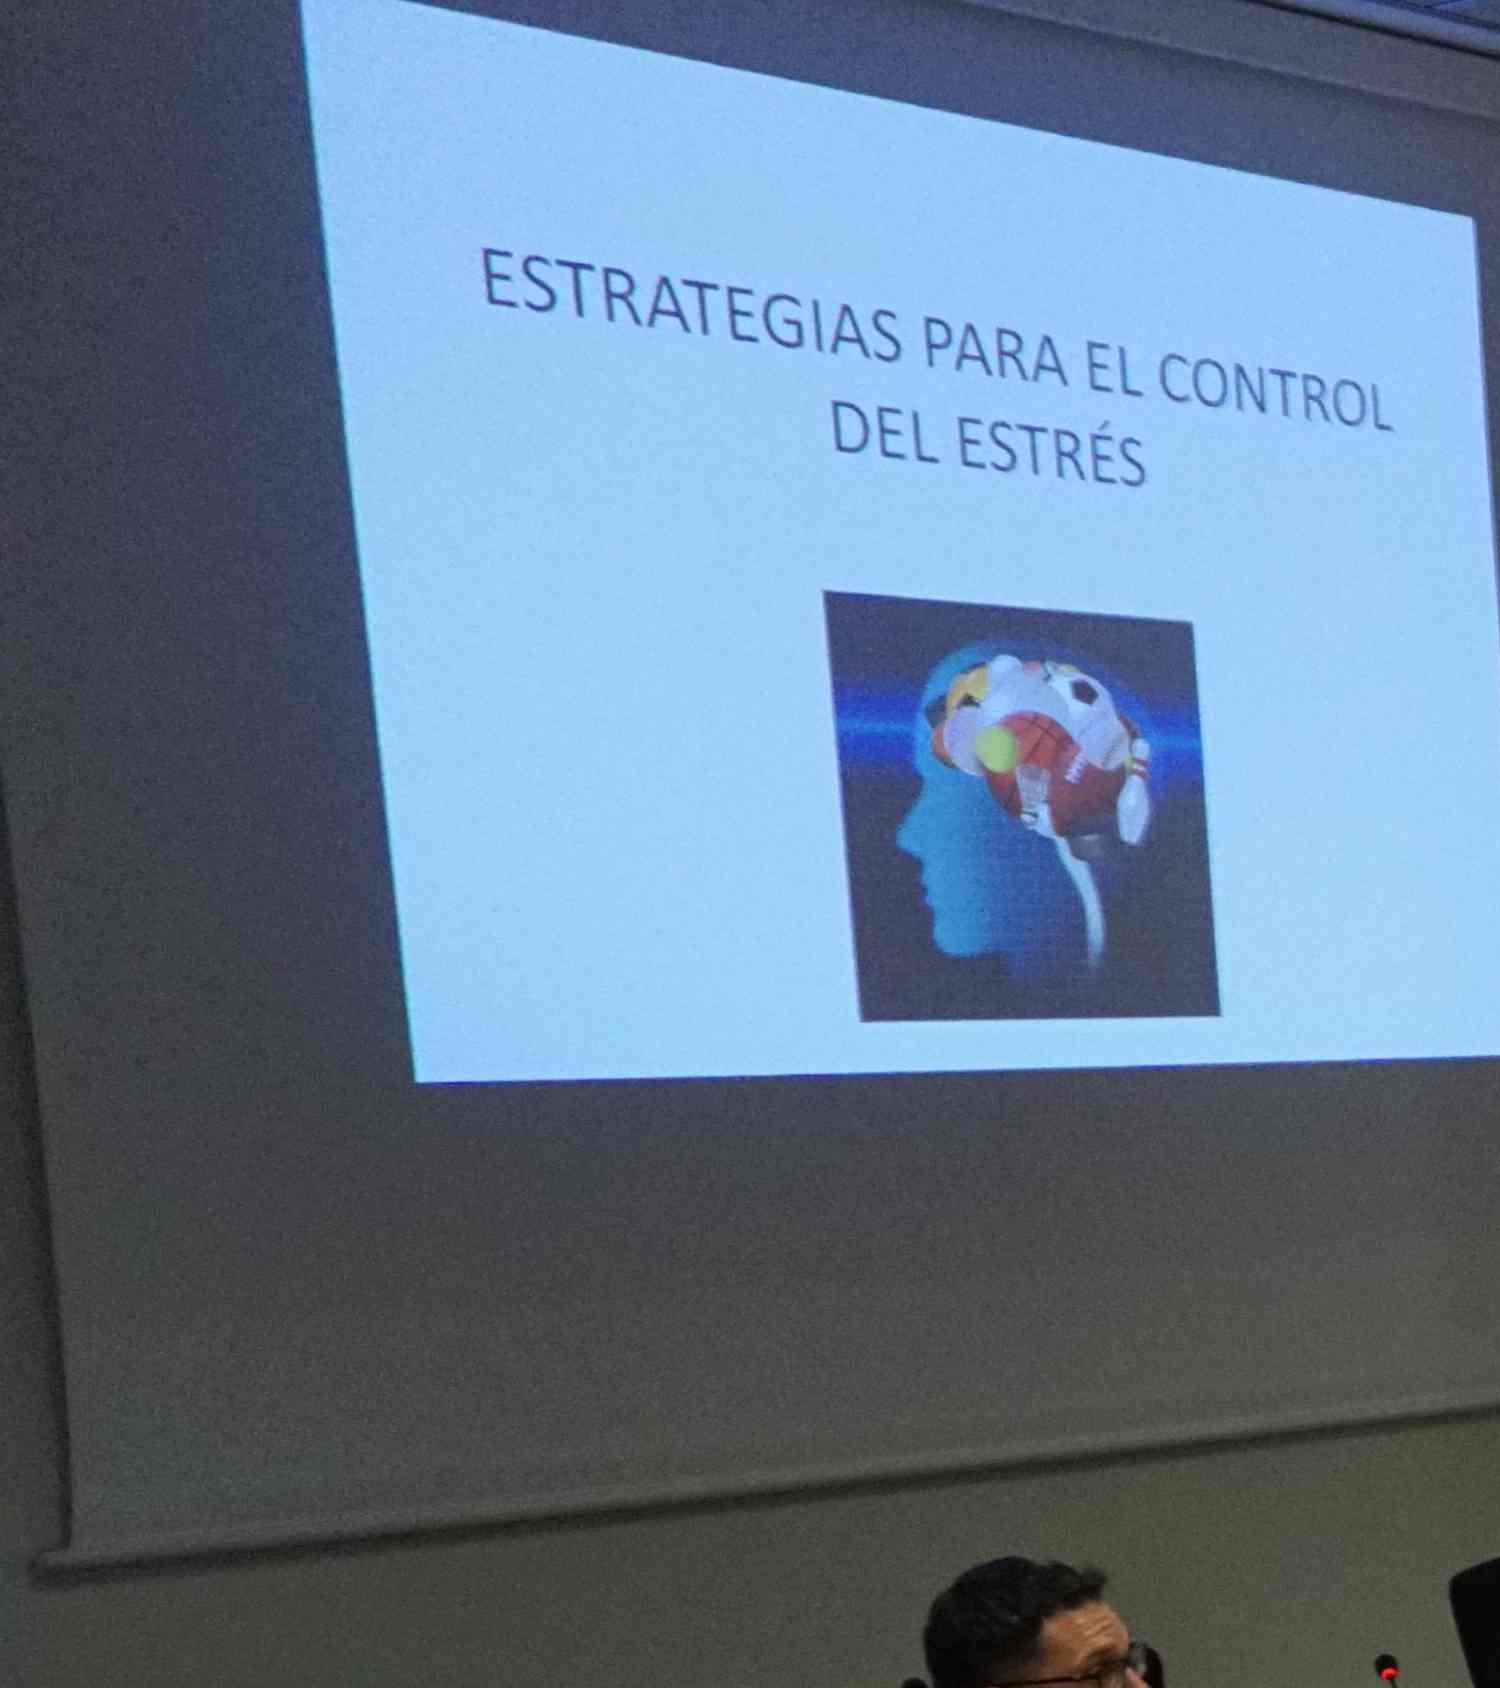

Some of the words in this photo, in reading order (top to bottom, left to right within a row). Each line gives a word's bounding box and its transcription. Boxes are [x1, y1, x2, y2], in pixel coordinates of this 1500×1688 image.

[481, 246, 902, 364] ESTRATEGIAS
[923, 316, 1069, 388] PARA
[1086, 340, 1144, 398] EL
[1158, 352, 1395, 432] CONTROL
[830, 399, 940, 464] DEL
[956, 416, 1147, 487] ESTRÉS
